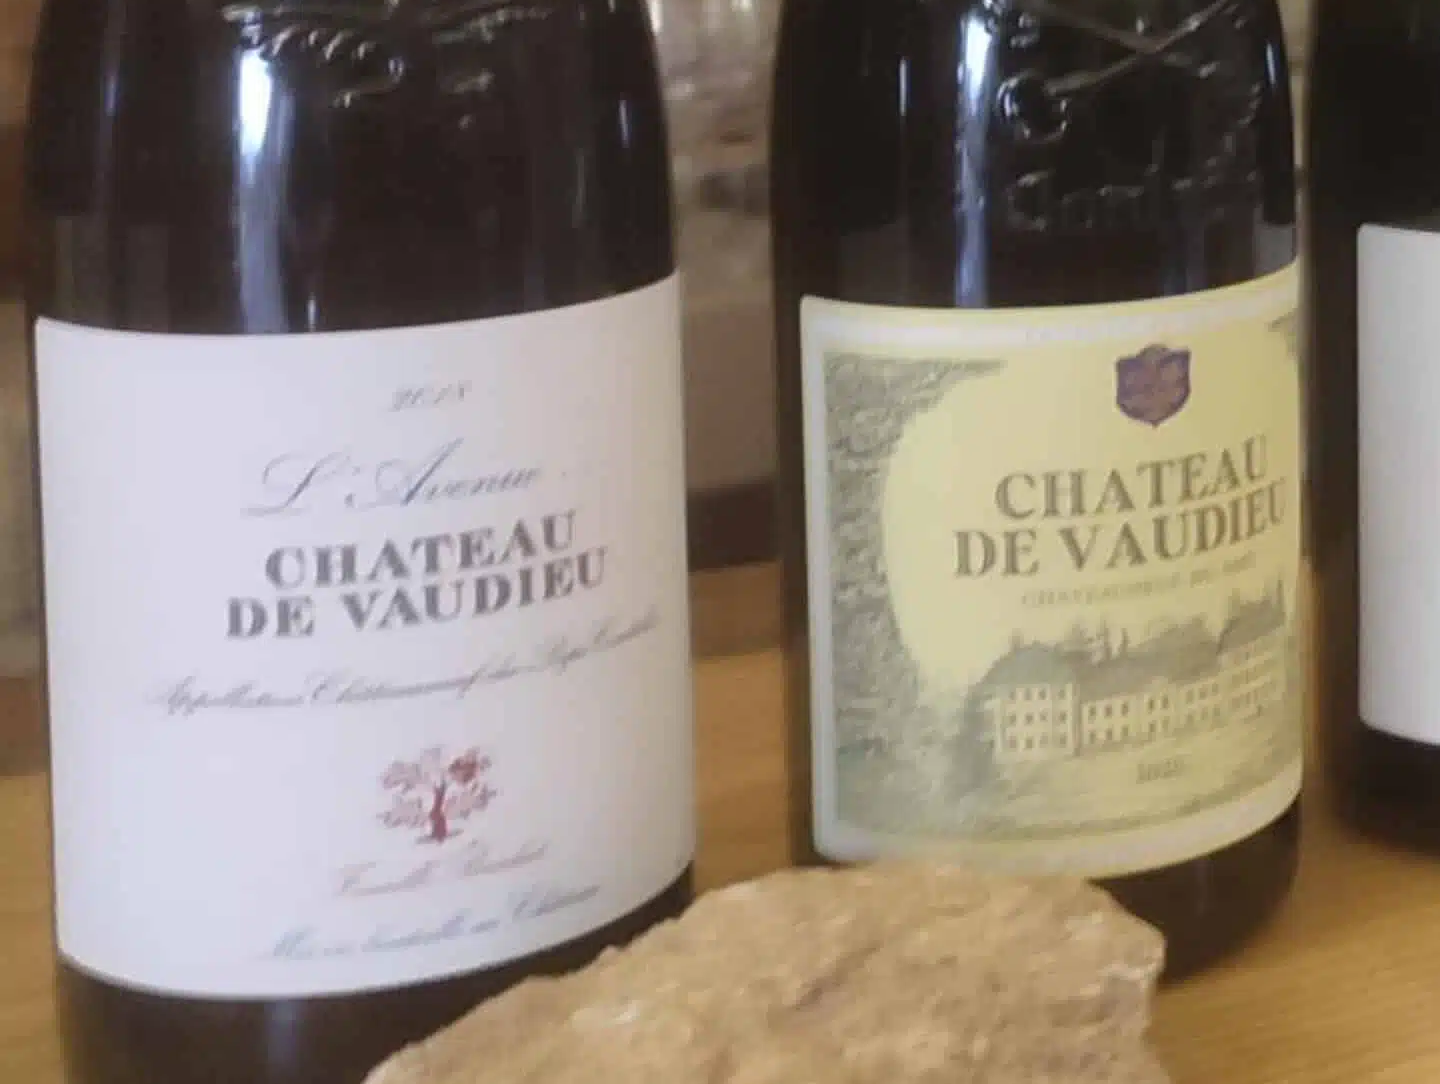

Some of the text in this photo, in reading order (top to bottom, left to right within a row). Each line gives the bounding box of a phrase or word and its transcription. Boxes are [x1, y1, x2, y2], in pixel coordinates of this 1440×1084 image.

[994, 434, 1269, 520] CHATEAU
[264, 510, 578, 591] CHATEAU
[953, 477, 1287, 579] DE VAUDIEU
[226, 595, 315, 640] DE
[342, 545, 610, 633] VAUDIEU
